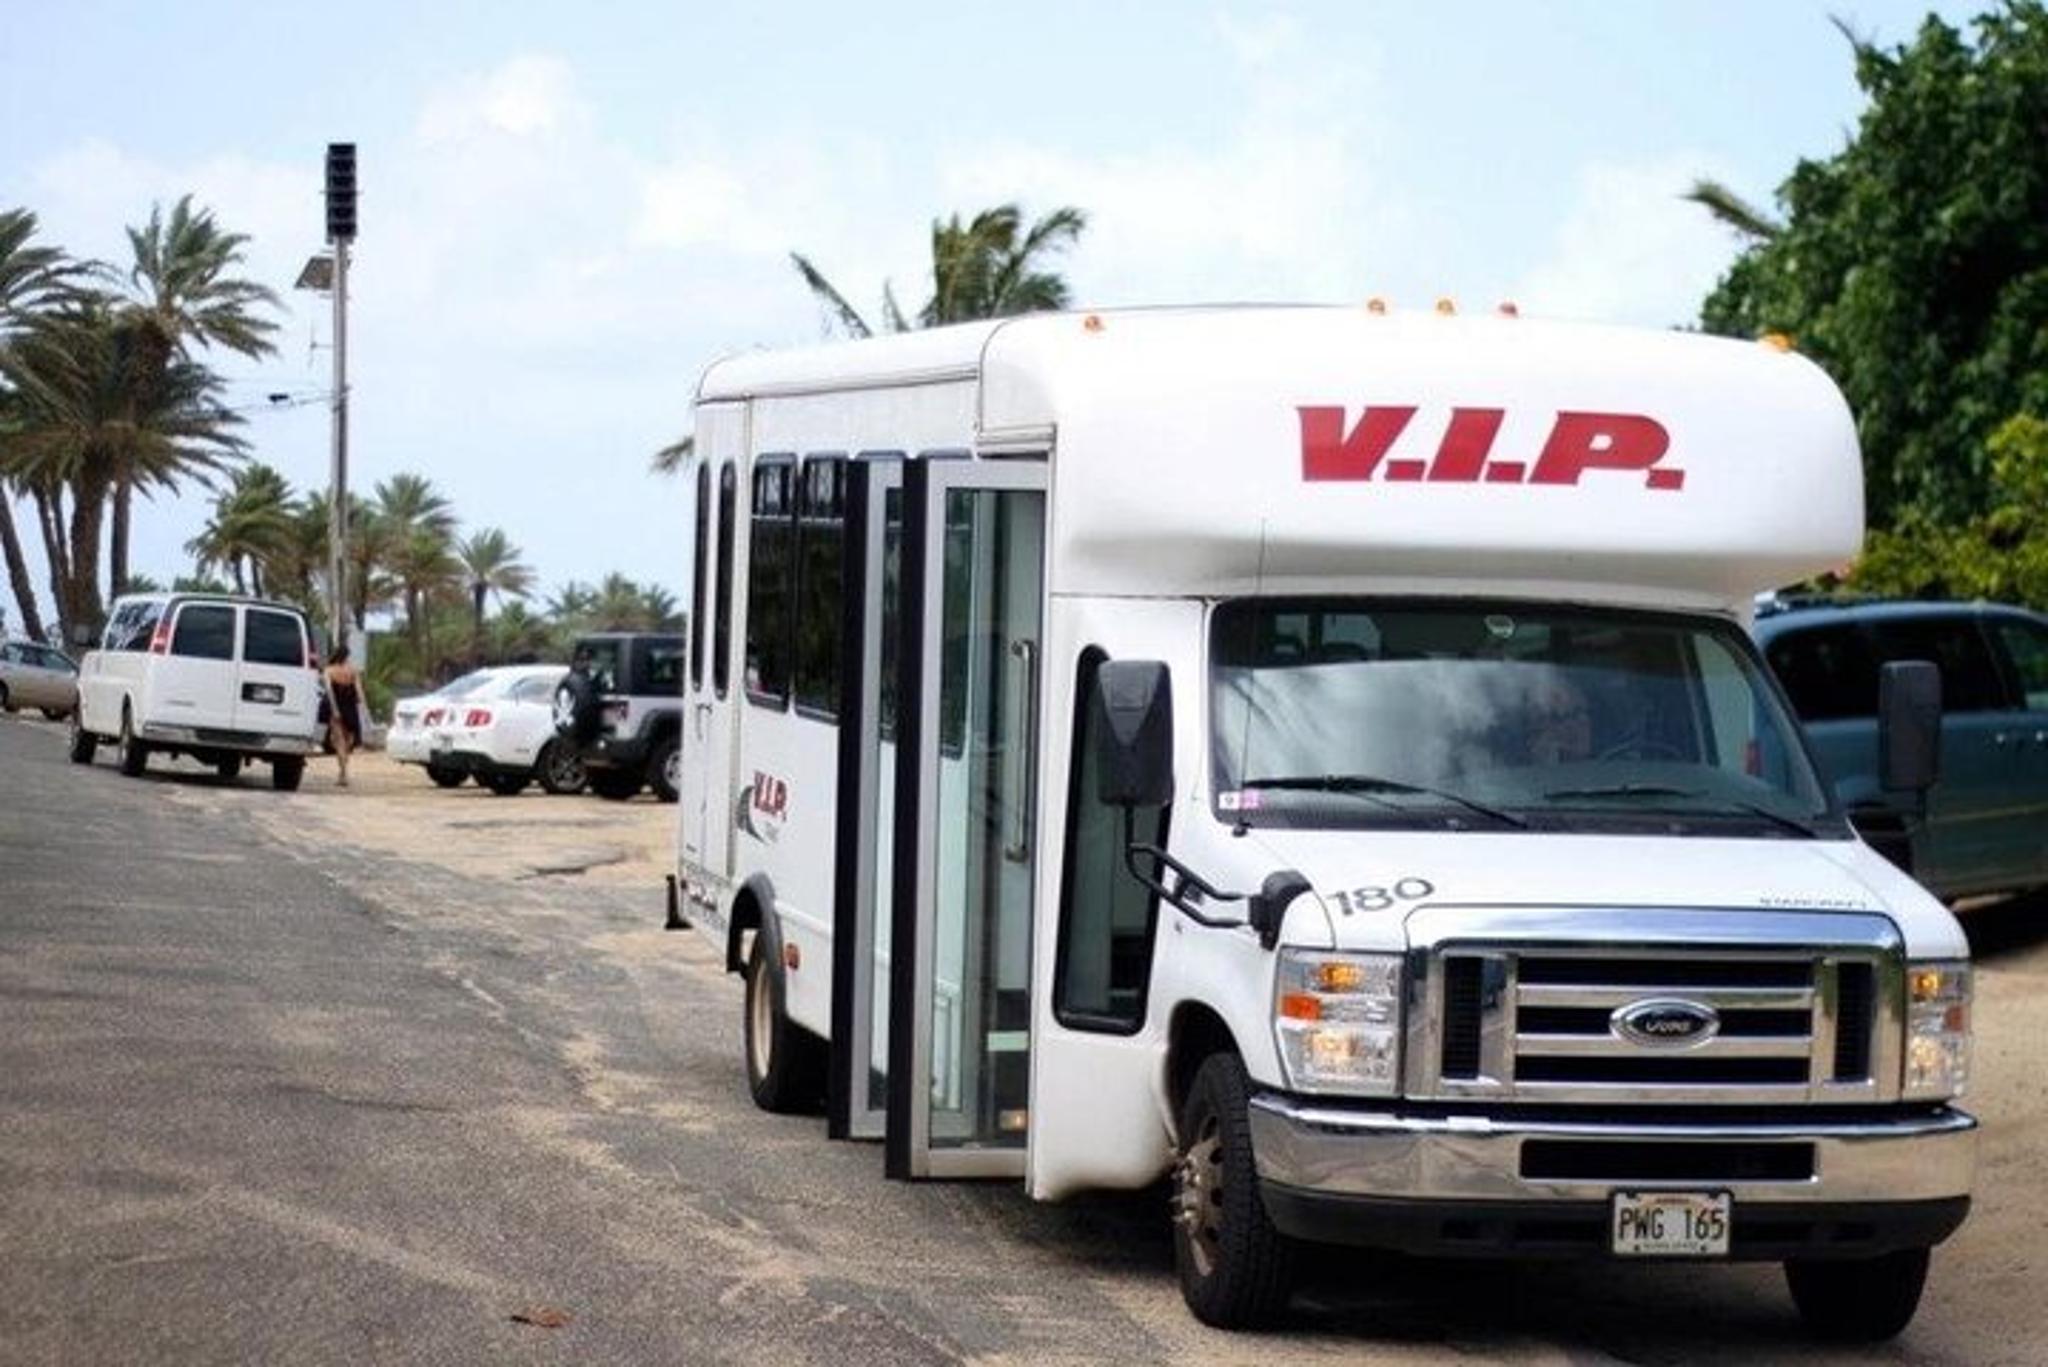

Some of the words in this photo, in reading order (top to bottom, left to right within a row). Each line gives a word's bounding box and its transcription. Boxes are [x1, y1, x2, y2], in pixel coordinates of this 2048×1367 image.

[1296, 405, 1685, 490] V.I.P.
[754, 770, 787, 822] V.I.P.
[1326, 878, 1434, 917] 180
[1619, 1207, 1665, 1240] PWG
[1684, 1207, 1725, 1240] 165
